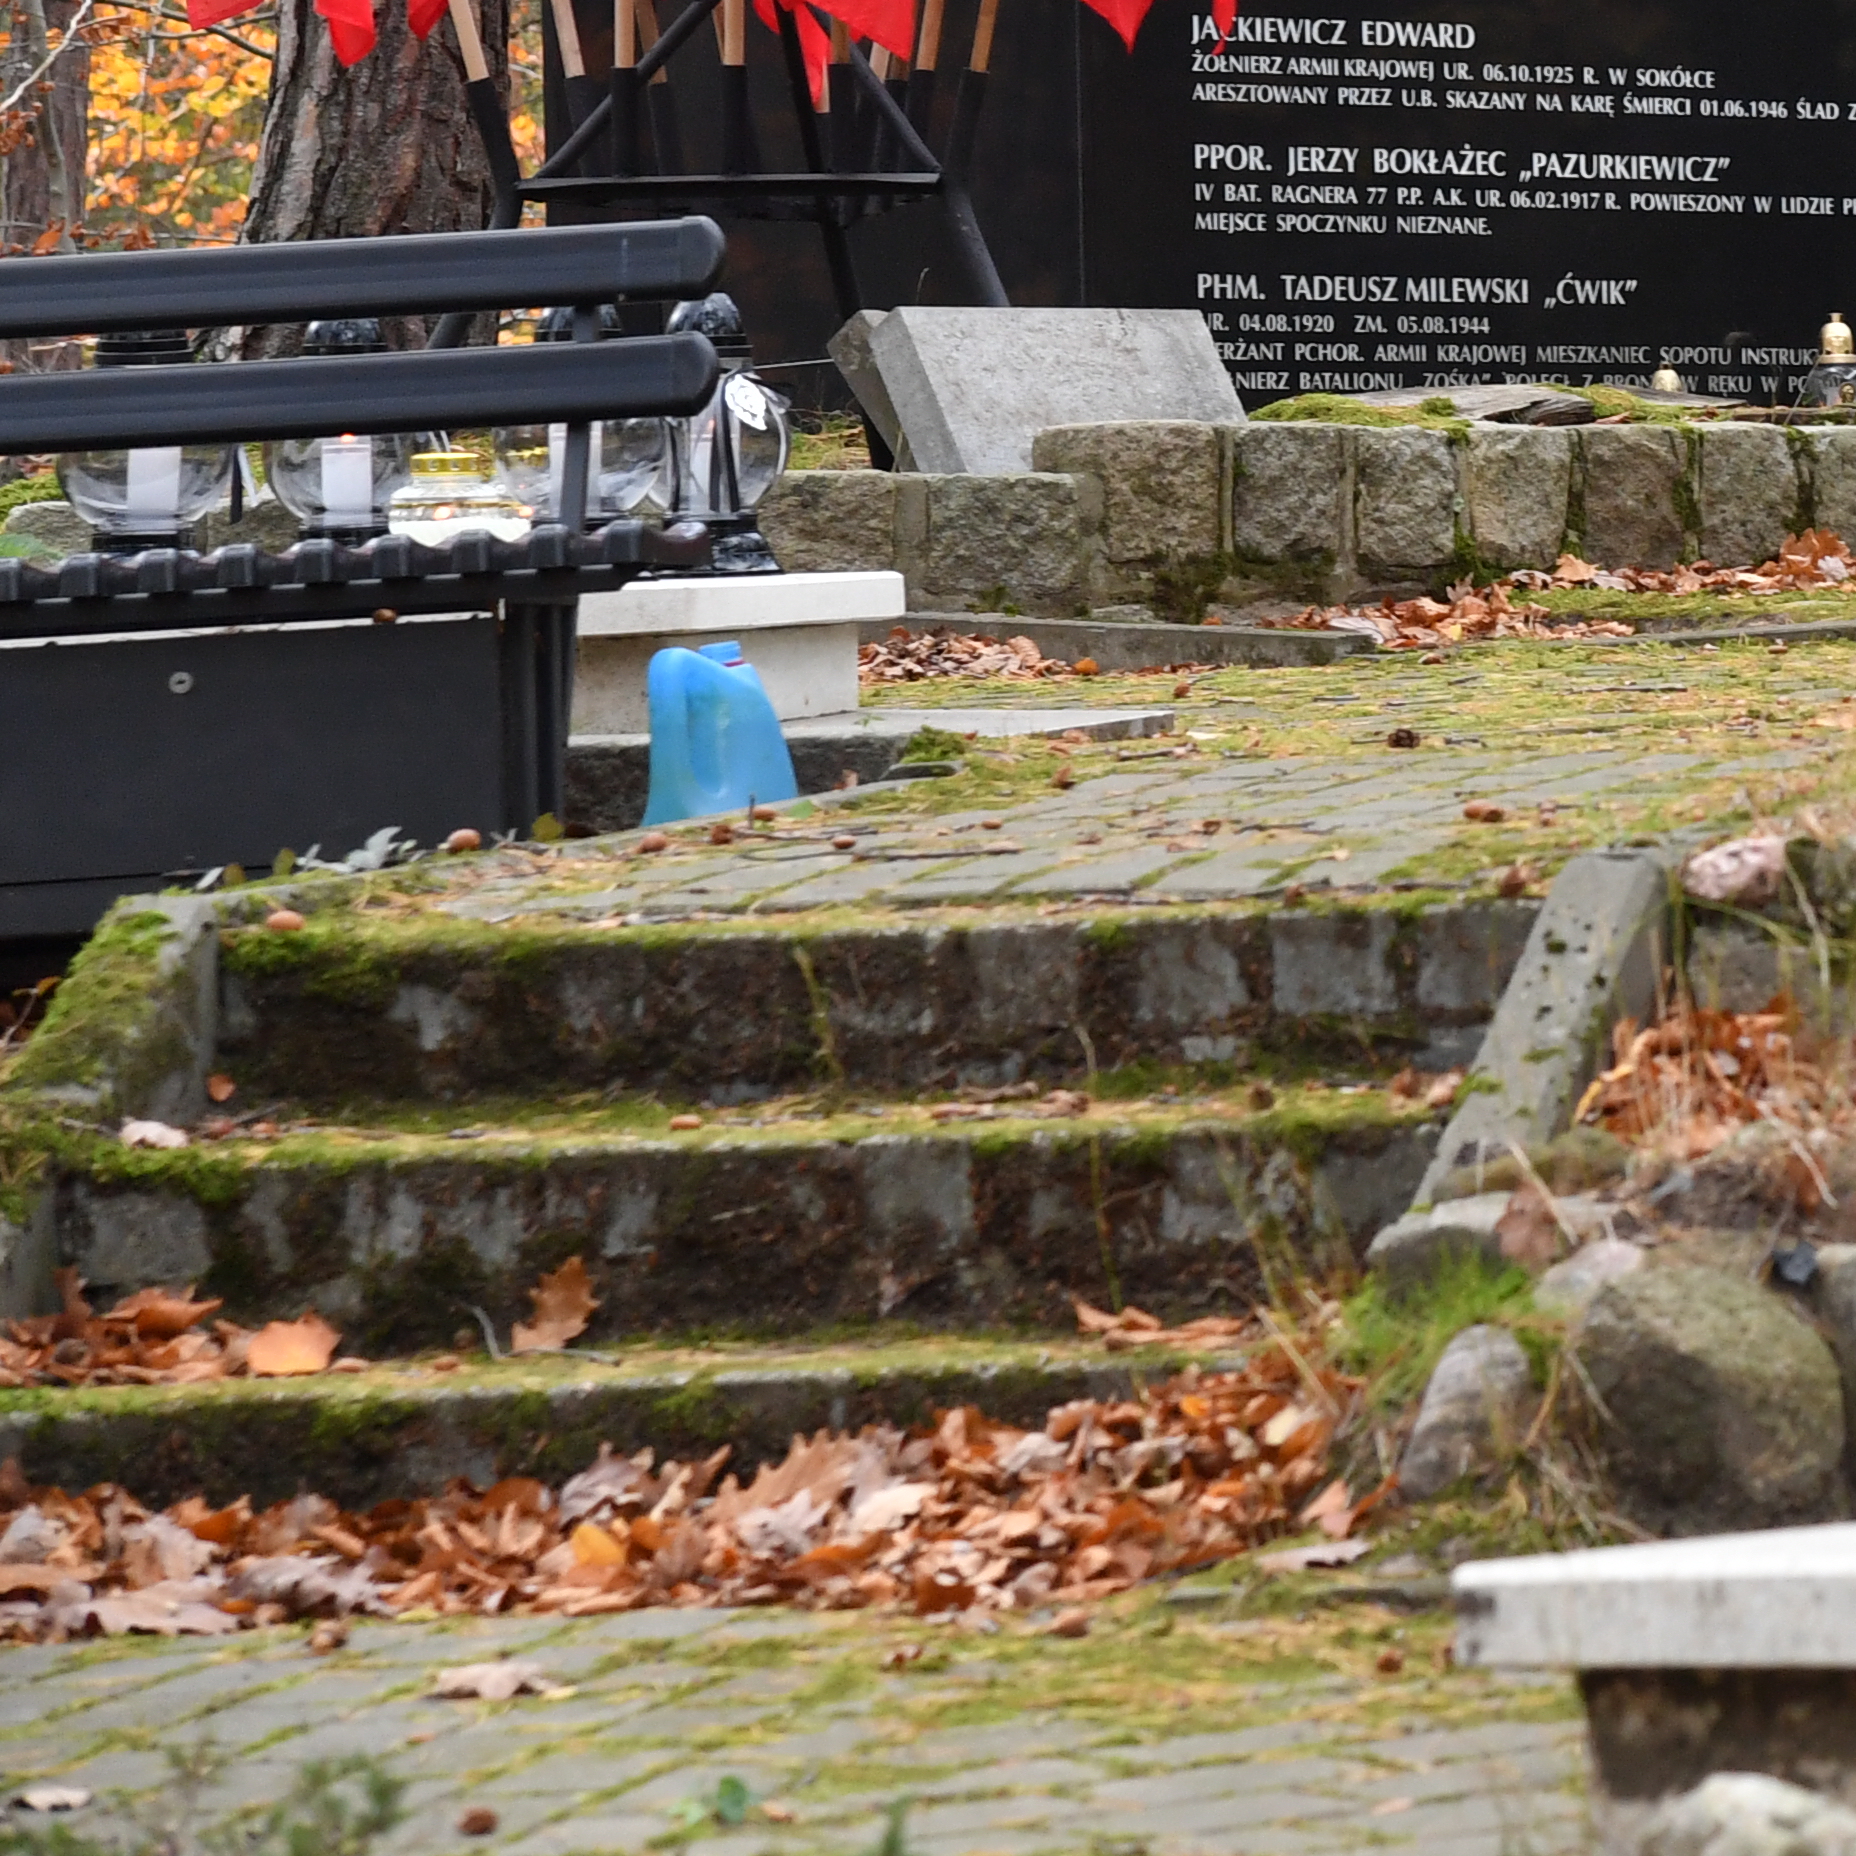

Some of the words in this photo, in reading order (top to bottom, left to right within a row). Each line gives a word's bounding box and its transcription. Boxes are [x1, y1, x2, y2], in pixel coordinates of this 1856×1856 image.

[1362, 20, 1475, 49] EDWARD
[1192, 54, 1282, 75] ŻOŁNIERZ
[1287, 57, 1339, 76] ARMII
[1344, 58, 1434, 82] KRAJOWEJ
[1444, 62, 1473, 80] UR.
[1483, 63, 1573, 84] 06.10.1925
[1584, 67, 1599, 84] R.
[1609, 68, 1627, 85] W
[1637, 68, 1714, 89] SOKÓŁCE
[1193, 83, 1328, 104] ARESZTOWANY
[1338, 87, 1392, 106] PRZEZ
[1402, 89, 1437, 107] U.B.
[1446, 90, 1526, 110] SKAZANY
[1537, 93, 1563, 112] NA
[1571, 94, 1614, 117] KARĘ
[1623, 95, 1691, 115] ŚMIERCI
[1700, 99, 1787, 118] 01.06.1946
[1797, 100, 1839, 120] ŚLAD
[1195, 144, 1271, 171] PPOR.
[1288, 146, 1358, 176] JERZY
[1374, 148, 1506, 176] BOKŁAŻEC
[1520, 153, 1730, 182] „PAZURKIEWICZ”
[1196, 212, 1266, 234] MIEJSCE
[1277, 214, 1386, 233] SPOCZYNKU
[1397, 216, 1492, 235] NIEZNANE.
[1198, 273, 1265, 300] PHM.
[1281, 274, 1398, 302] TADEUSZ
[1406, 277, 1528, 304] MILEWSKI
[1545, 274, 1637, 309] „ĆWIK”
